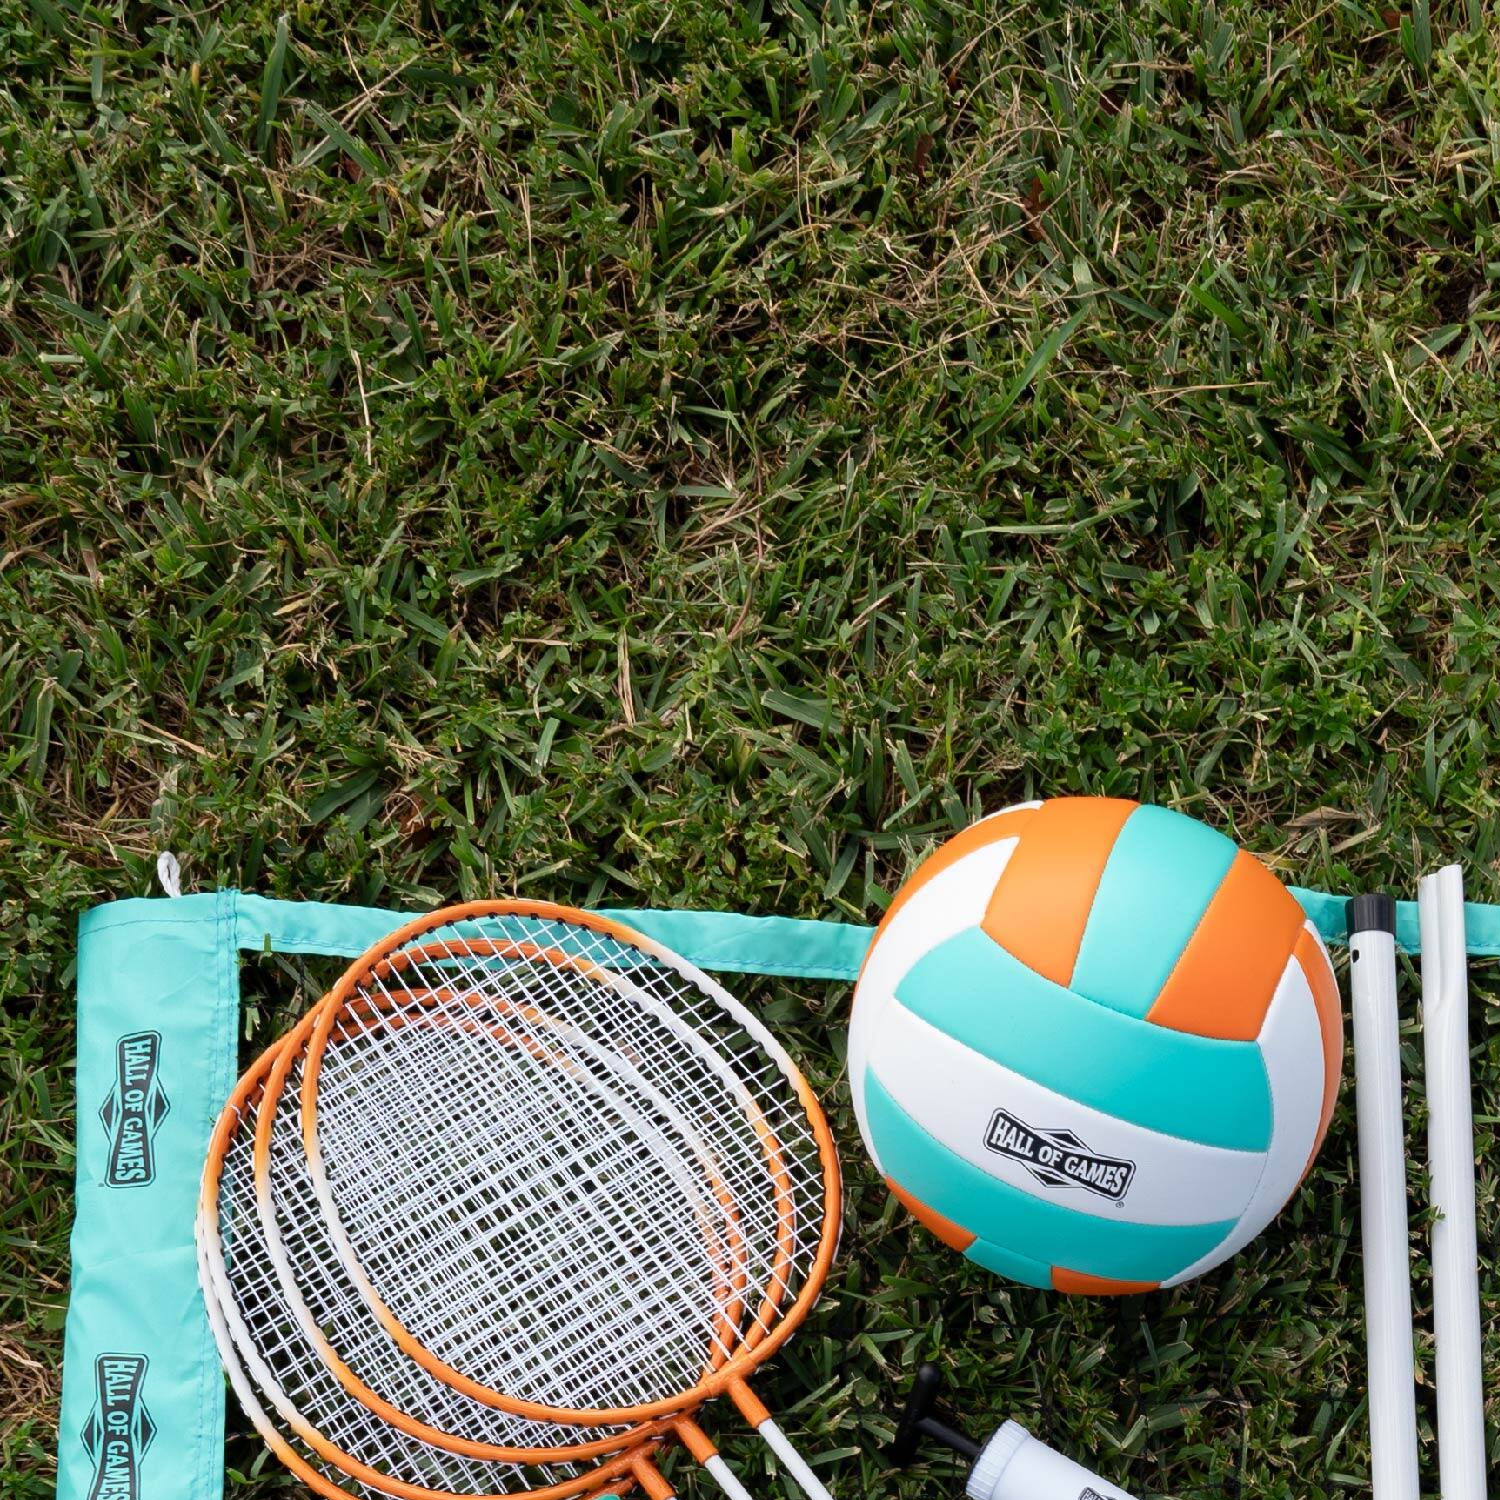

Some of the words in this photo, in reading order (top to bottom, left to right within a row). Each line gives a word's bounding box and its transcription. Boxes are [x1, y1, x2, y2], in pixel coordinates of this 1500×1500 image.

[123, 1039, 152, 1086] HALL
[124, 1088, 145, 1112] OF
[115, 1116, 146, 1181] GAMES
[990, 1116, 1034, 1158] HALL
[1038, 1146, 1063, 1168] OF
[1064, 1156, 1128, 1193] GAMES
[103, 1360, 139, 1406] HALL
[107, 1410, 129, 1436] OF
